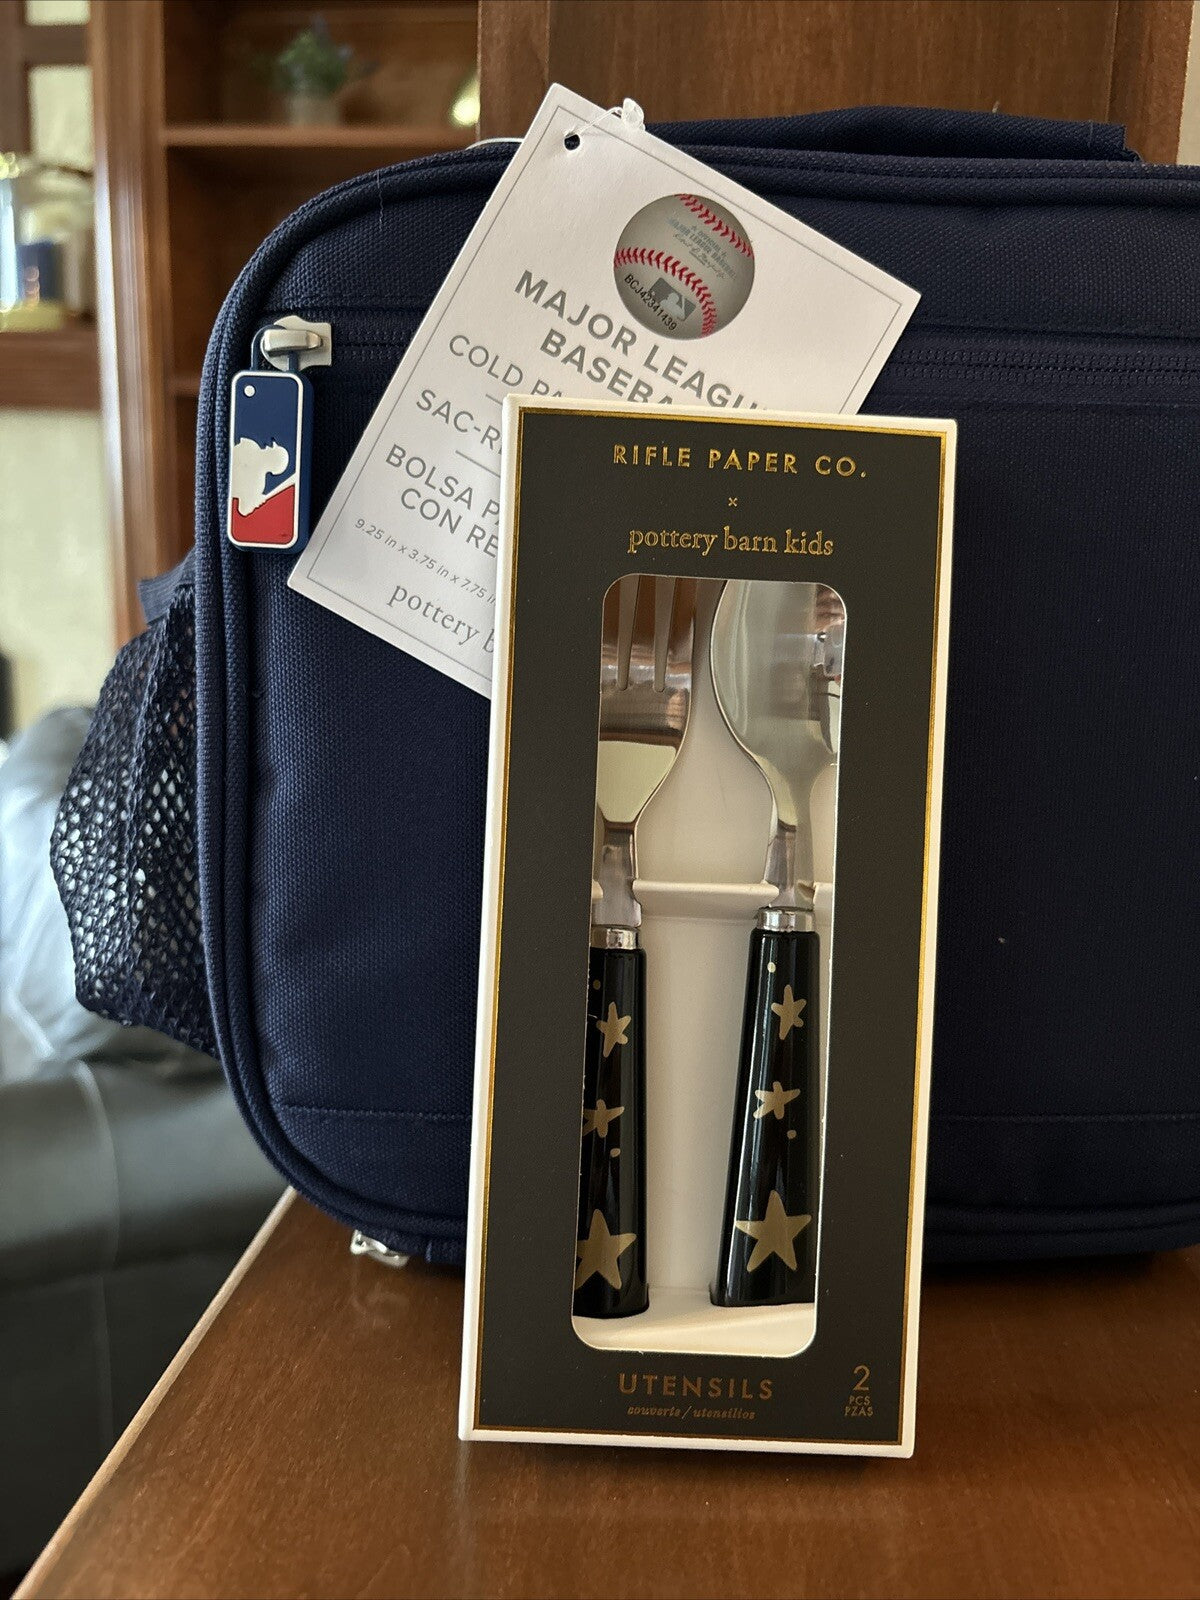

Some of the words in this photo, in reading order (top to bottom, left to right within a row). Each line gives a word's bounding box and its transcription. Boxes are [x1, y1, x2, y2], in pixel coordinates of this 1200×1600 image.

[514, 269, 638, 357] MAJOR
[624, 272, 678, 331] BCJ42341439
[449, 334, 524, 387] COLD
[416, 389, 502, 455] SAC-R
[385, 443, 474, 511] BOLSA
[613, 443, 692, 468] RIFLE
[708, 448, 798, 474] PAPER
[814, 454, 867, 478] CO.
[400, 487, 463, 535] CON
[354, 518, 385, 540] 9.25
[384, 535, 398, 548] in
[398, 545, 408, 554] x
[408, 549, 437, 570] 3.75
[436, 565, 450, 578] in
[450, 574, 460, 584] x
[460, 578, 488, 599] 7.75
[627, 528, 718, 556] pottery
[723, 525, 778, 554] barn
[783, 528, 835, 556] kids
[386, 585, 480, 646] pottery
[618, 1372, 774, 1400] UTENSILS
[849, 1395, 871, 1406] PCS
[852, 1365, 871, 1391] 2
[844, 1406, 874, 1417] PZAS
